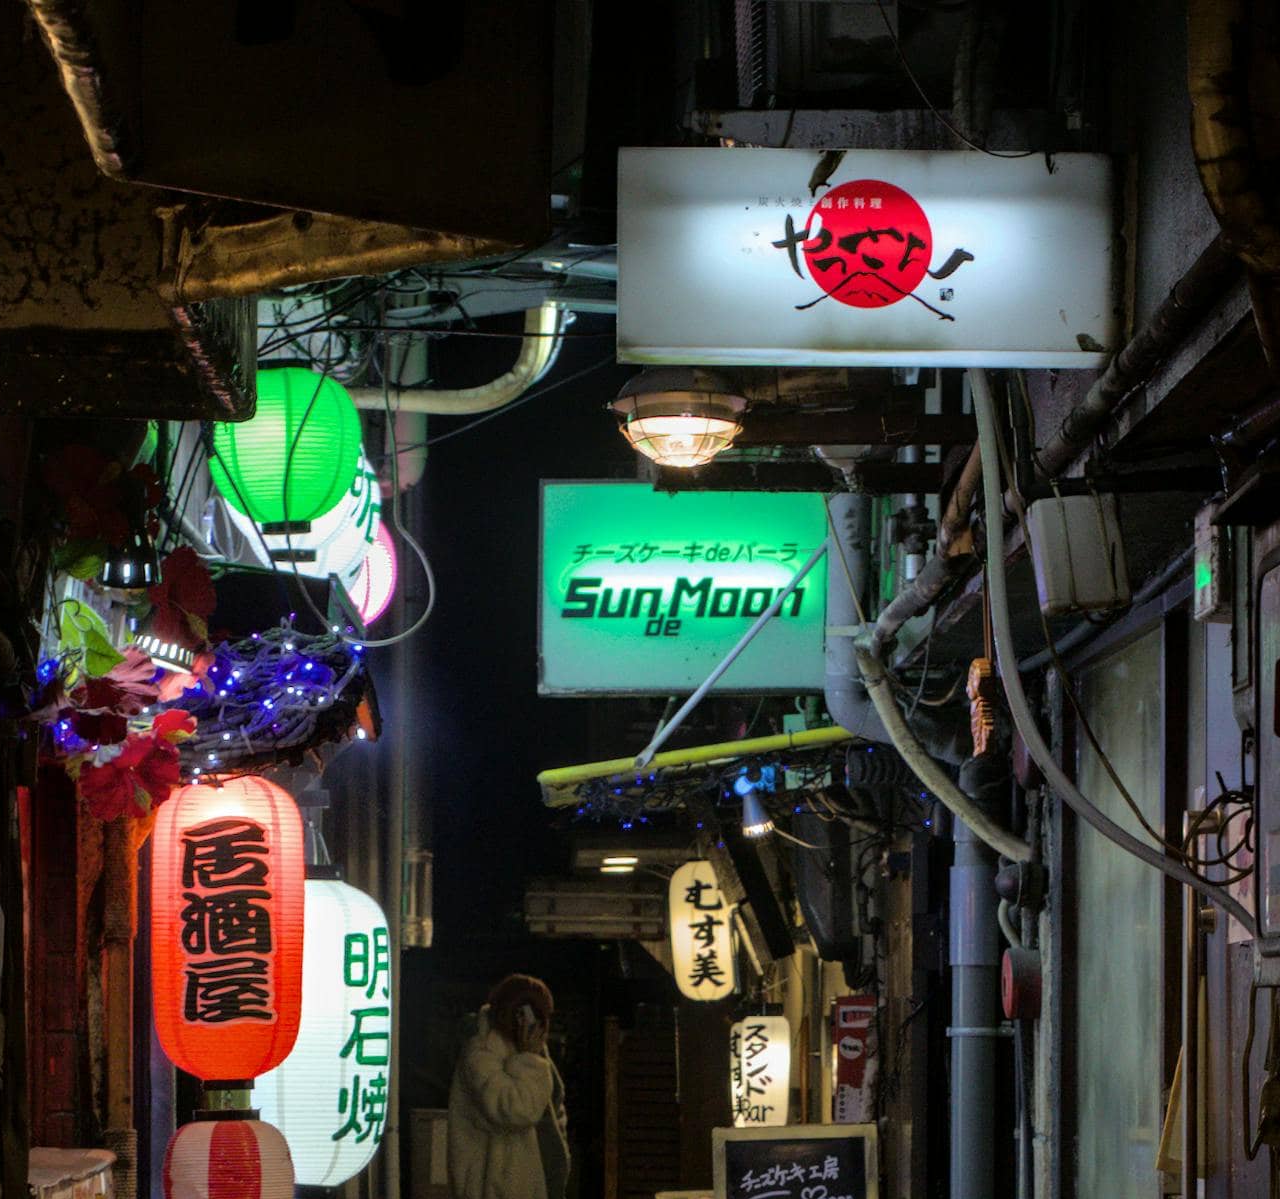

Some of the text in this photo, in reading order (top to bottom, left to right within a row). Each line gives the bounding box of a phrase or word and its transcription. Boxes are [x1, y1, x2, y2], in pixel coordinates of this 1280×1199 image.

[561, 576, 808, 619] Sun Moon
[645, 613, 683, 638] de
[180, 818, 273, 1023] 居酒屋
[684, 879, 726, 988] むす美
[331, 926, 390, 1145] 明石焼
[745, 1023, 773, 1097] スタンド
